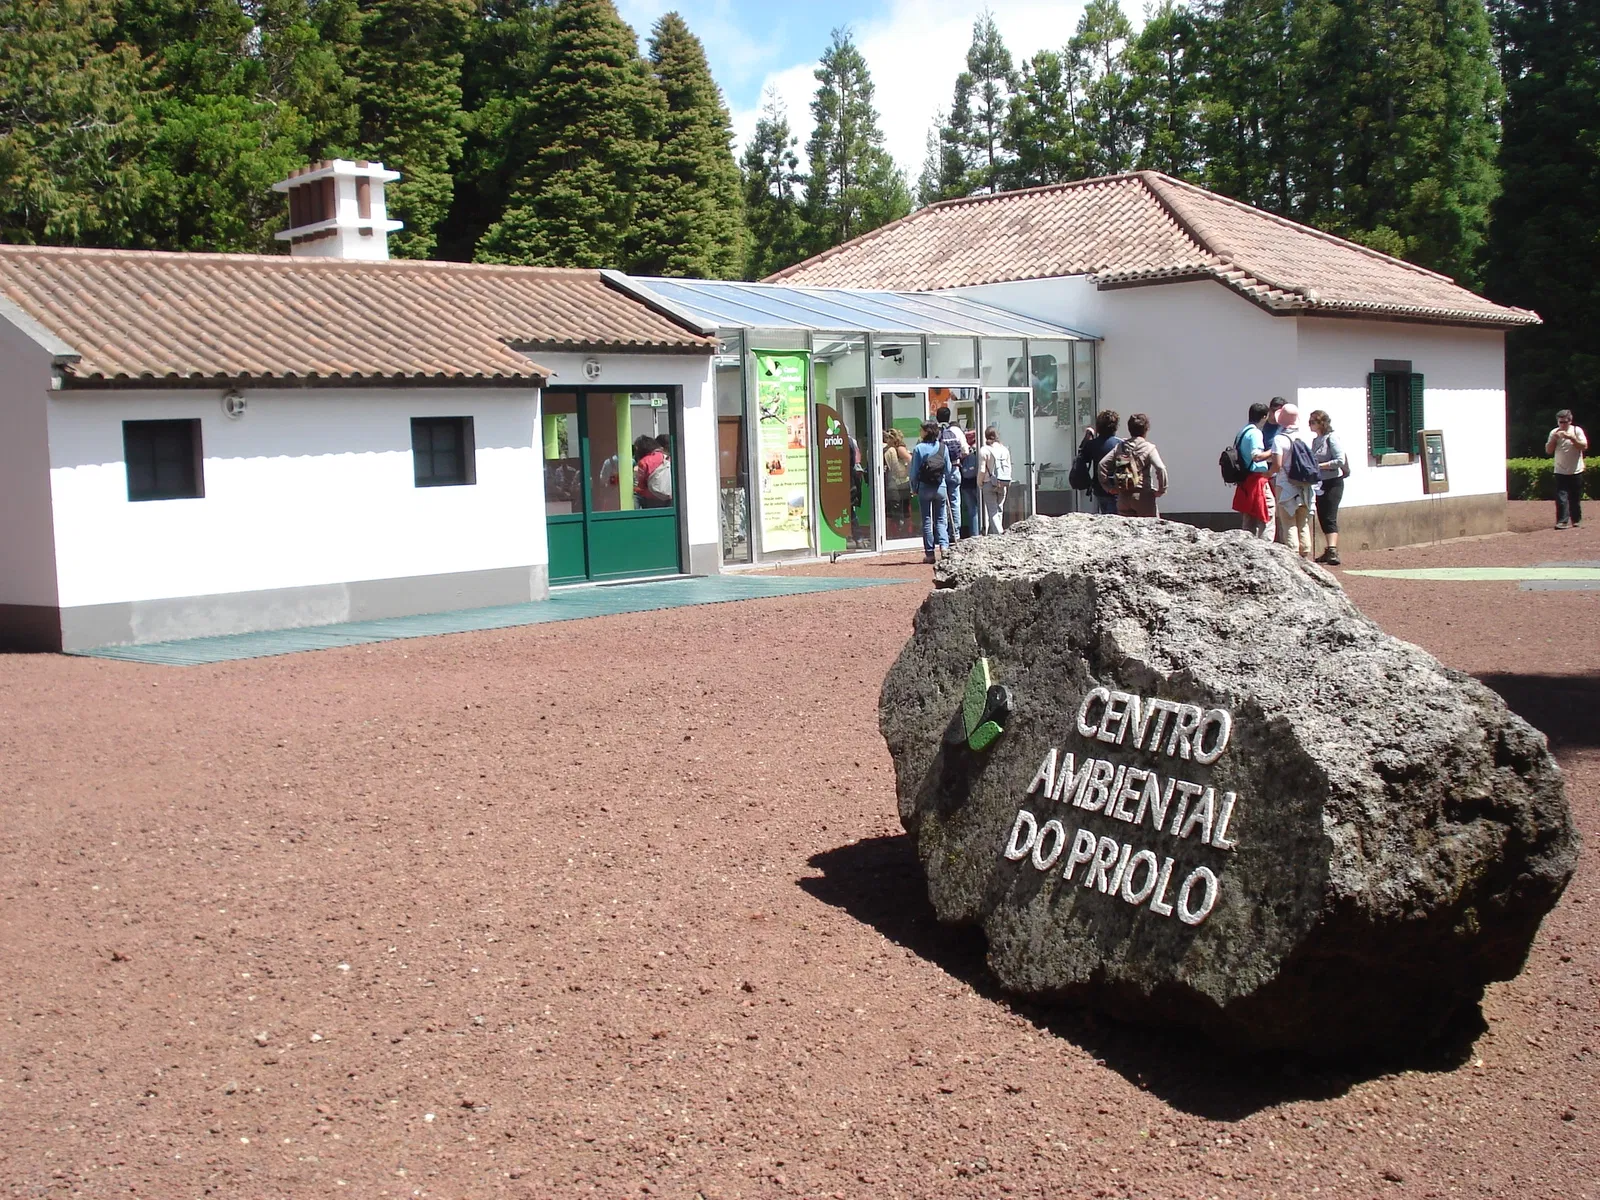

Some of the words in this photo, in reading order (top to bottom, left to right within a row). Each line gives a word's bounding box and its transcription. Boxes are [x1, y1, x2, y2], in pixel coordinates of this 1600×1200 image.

[824, 435, 844, 448] priolo
[1077, 687, 1232, 765] CENTRO
[1026, 748, 1237, 850] AMBIENTAL
[1004, 809, 1066, 871] DO
[1062, 828, 1218, 925] PRIOLO
